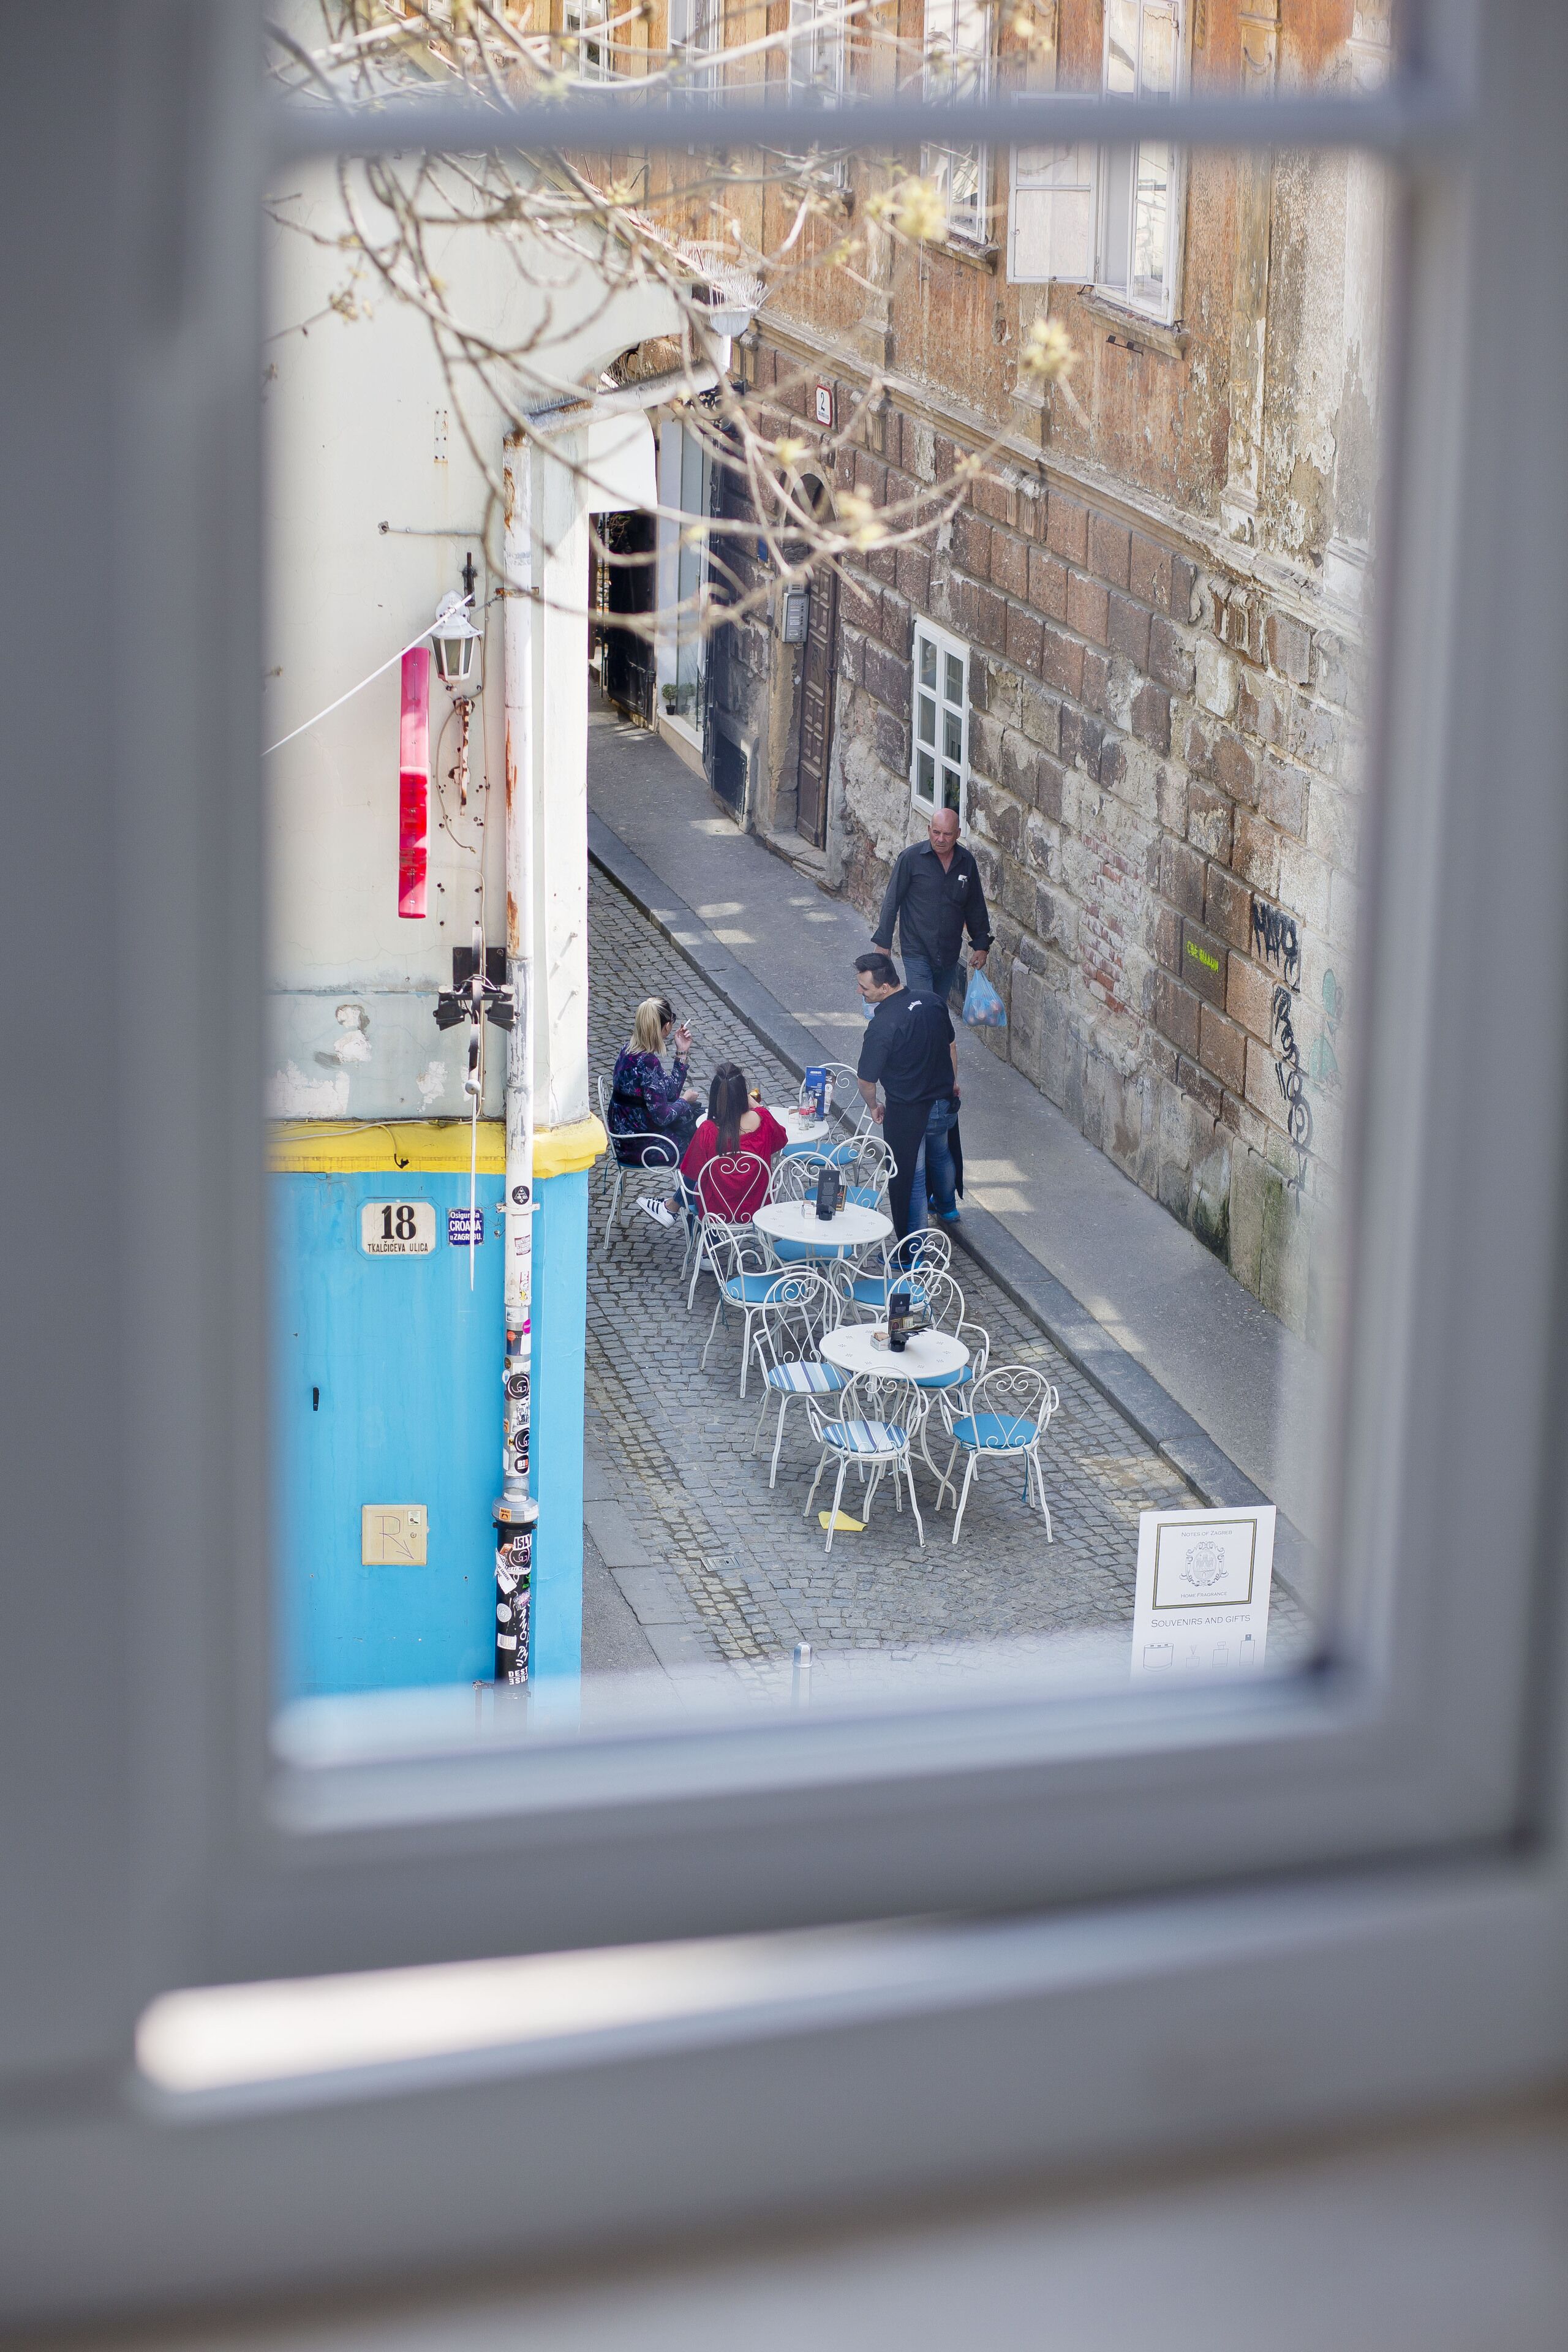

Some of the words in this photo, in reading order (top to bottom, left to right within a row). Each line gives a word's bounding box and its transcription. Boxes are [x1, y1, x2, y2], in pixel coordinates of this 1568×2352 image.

[820, 391, 825, 412] 2
[381, 1205, 417, 1240] 18
[368, 1240, 405, 1253] TKALČIĆEVA
[409, 1243, 428, 1252] ULICA
[1151, 1618, 1203, 1628] SOUVENIRS
[1205, 1616, 1224, 1625] AND
[1225, 1615, 1251, 1624] GIFTS
